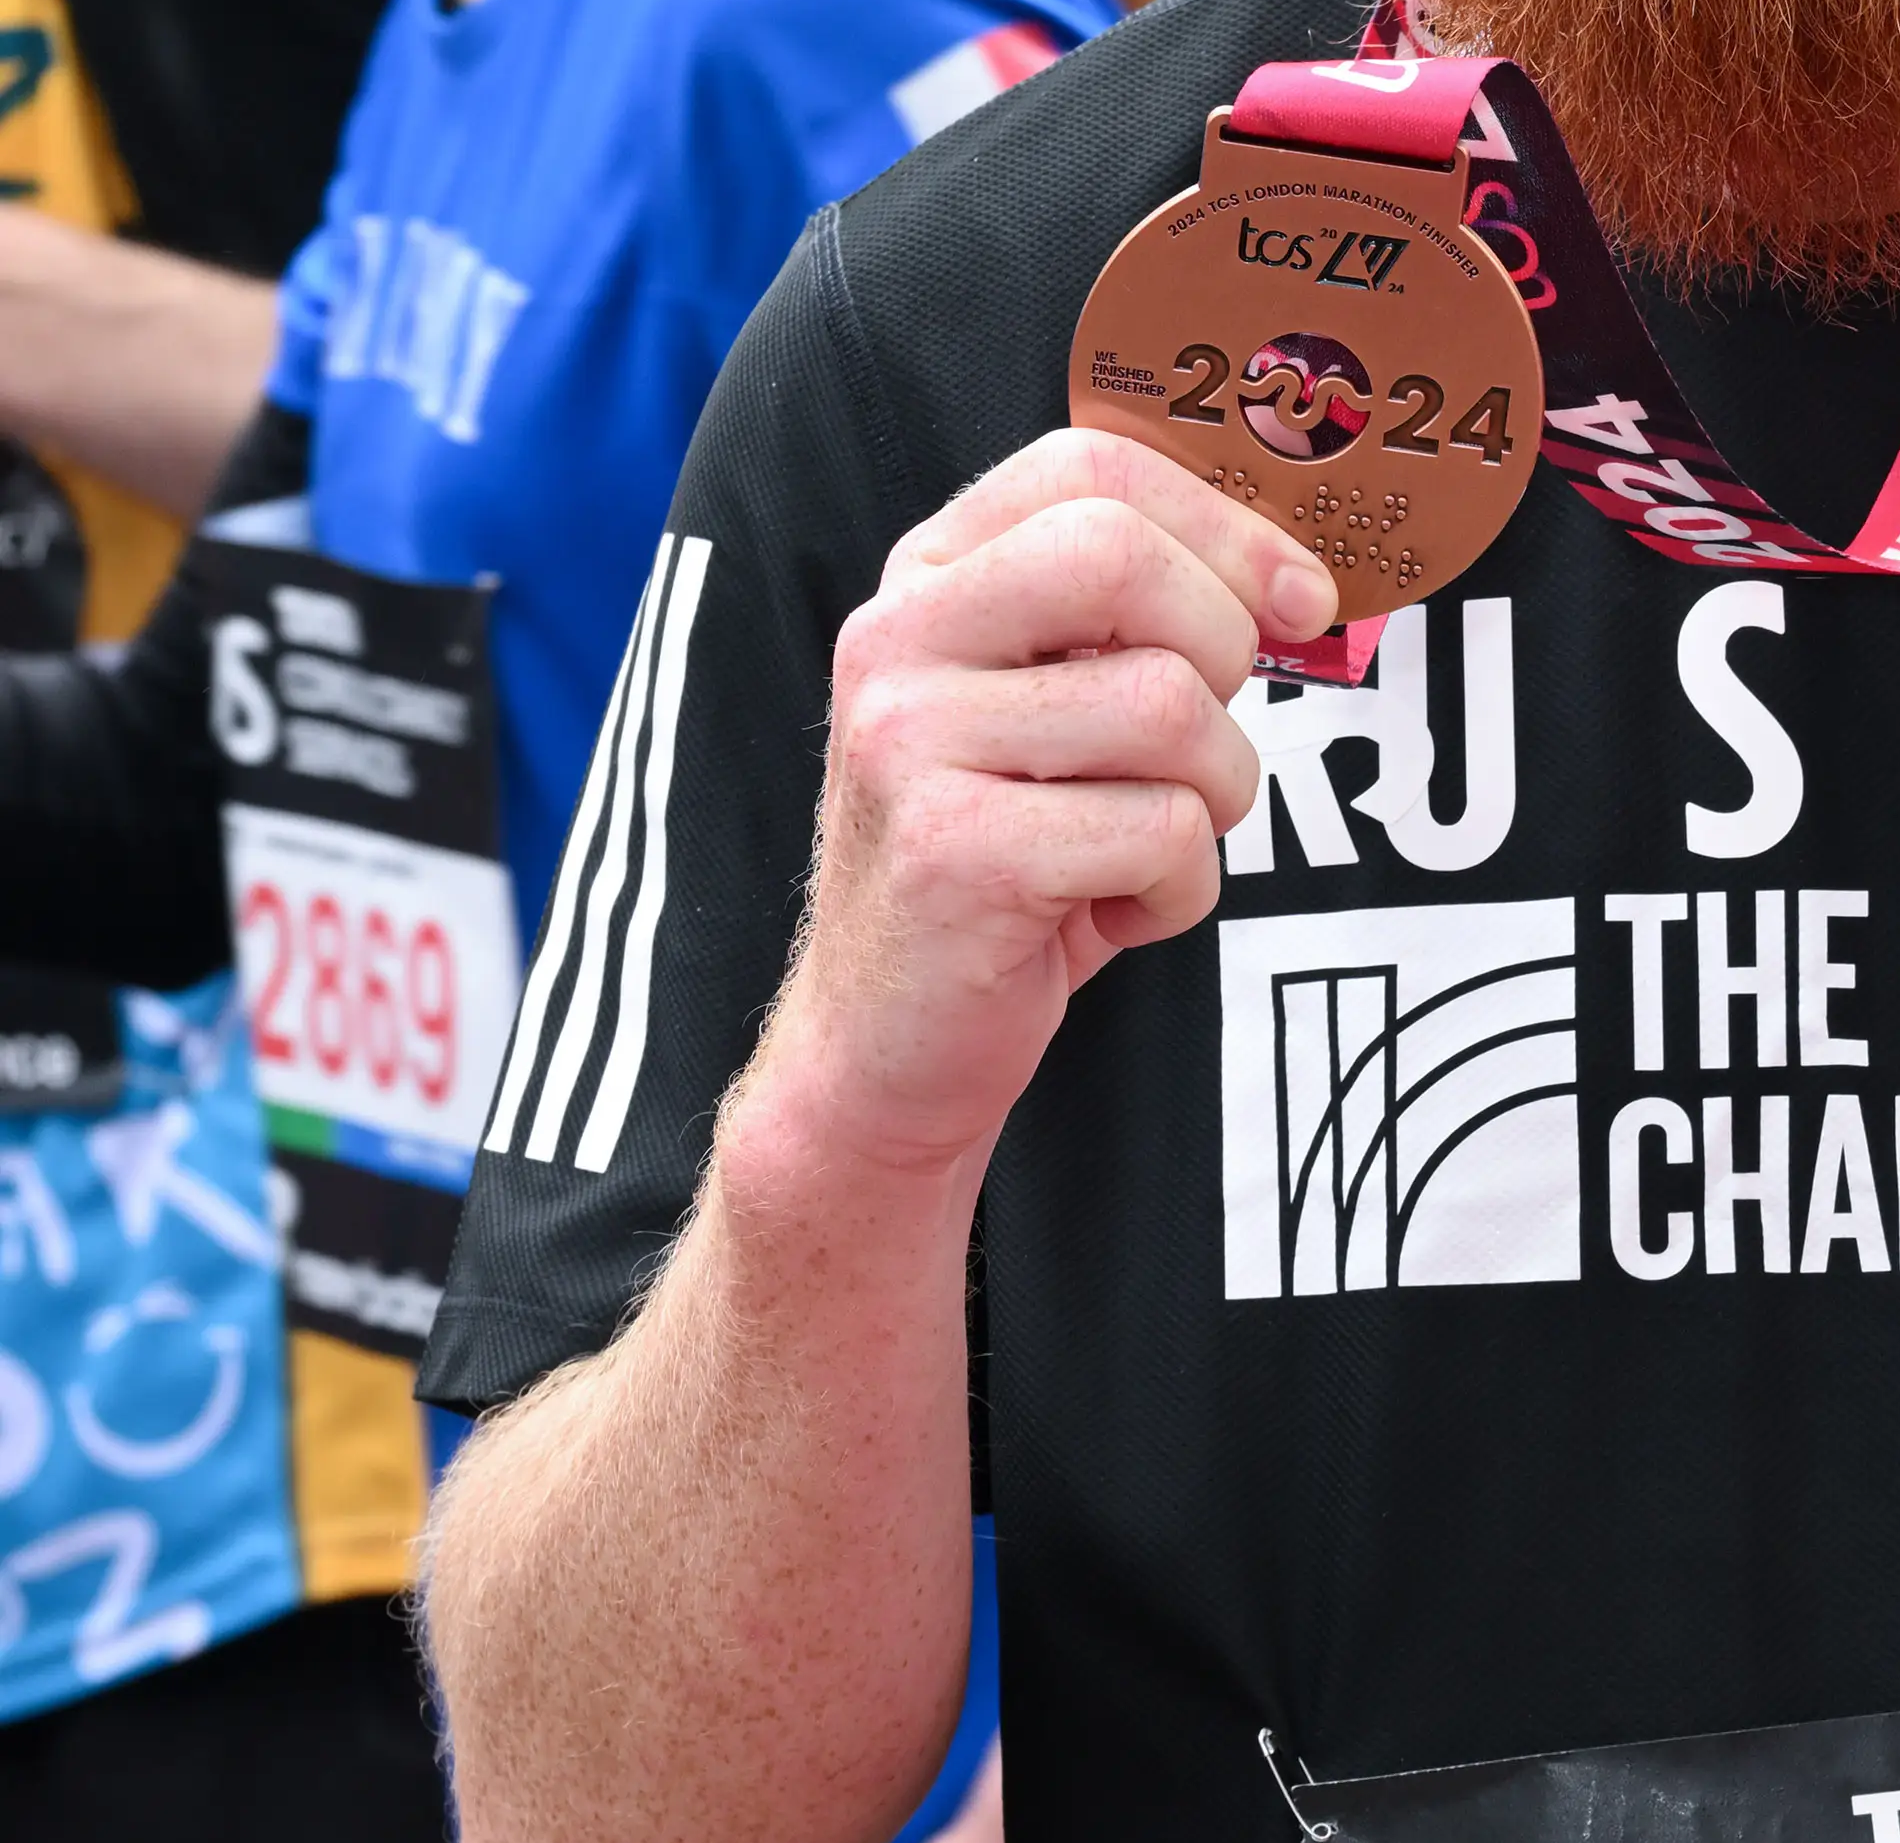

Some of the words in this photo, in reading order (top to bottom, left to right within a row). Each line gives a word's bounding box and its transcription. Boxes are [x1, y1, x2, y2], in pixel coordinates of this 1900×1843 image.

[1168, 209, 1205, 238] 2024
[1208, 193, 1240, 214] TCS
[1244, 184, 1316, 202] LONDON
[1323, 185, 1417, 227] MARATHON
[1419, 222, 1480, 280] FINISHER
[1238, 217, 1314, 270] tcs
[1091, 363, 1154, 383] FINISHED
[1095, 350, 1118, 364] WE
[1091, 376, 1167, 399] TOGETHER
[1604, 891, 1868, 1072] THE
